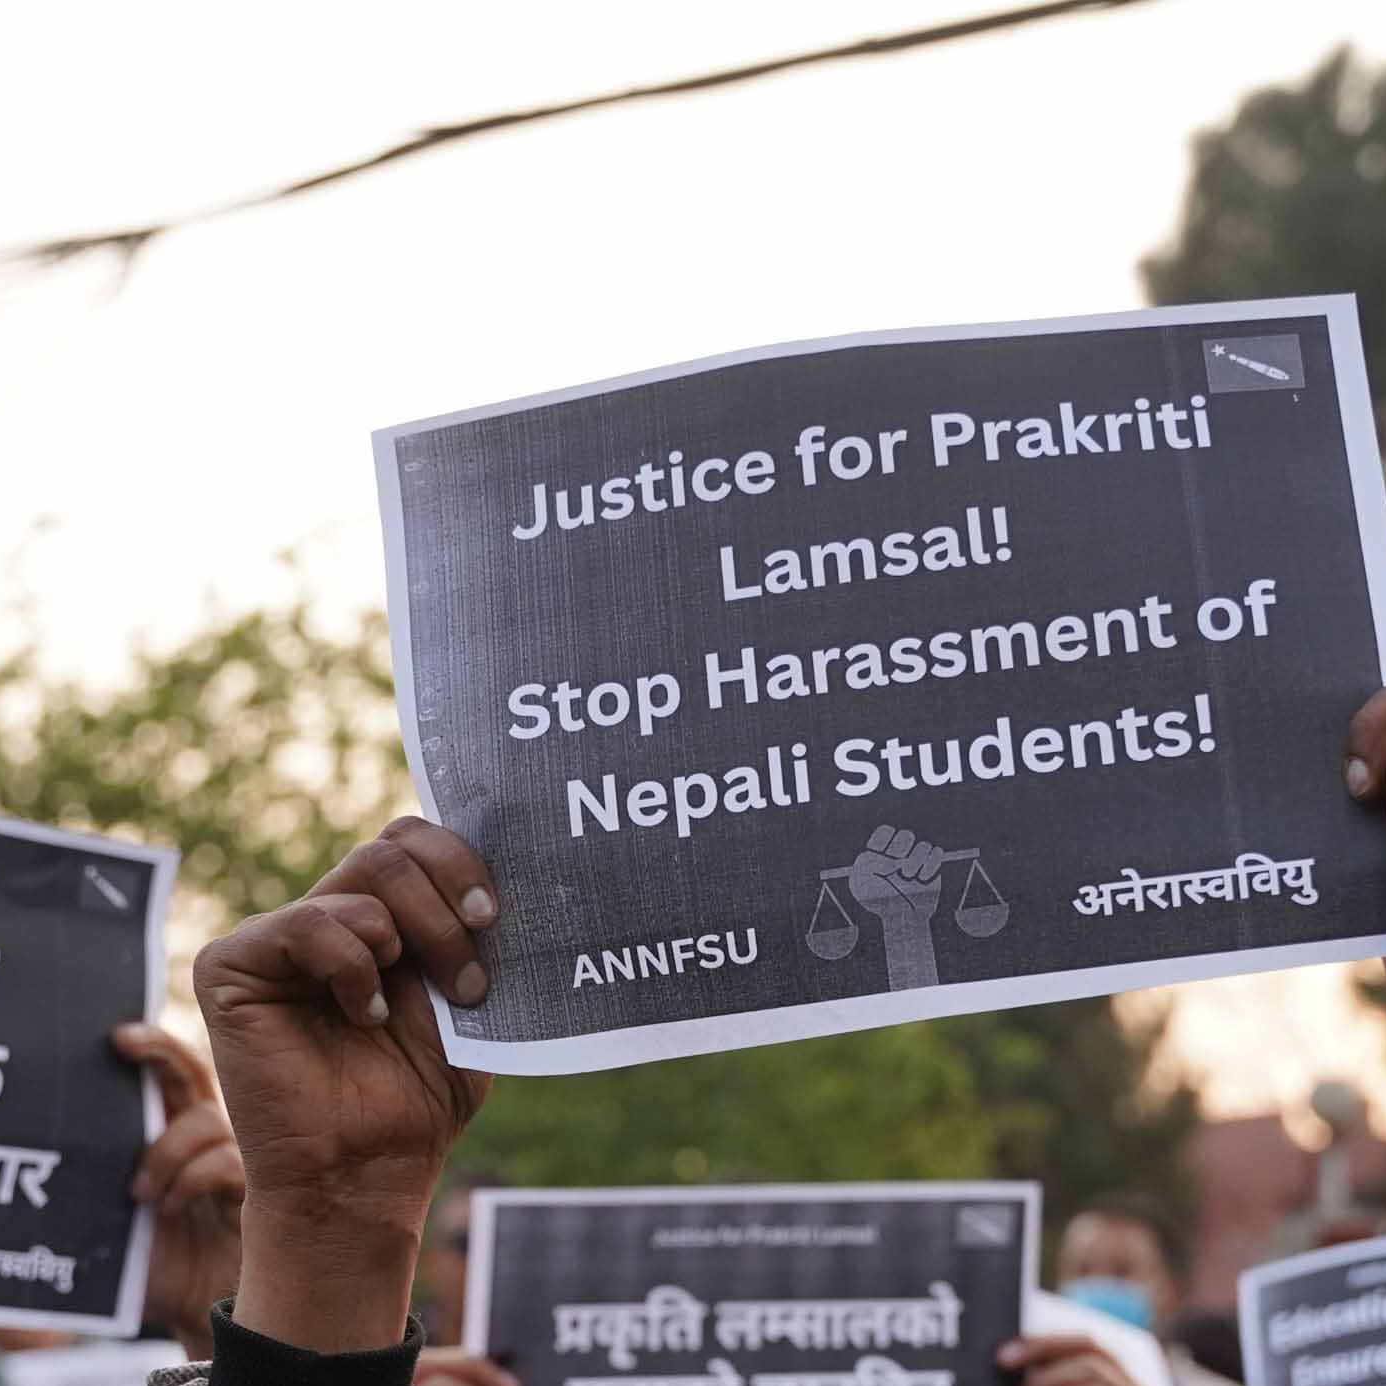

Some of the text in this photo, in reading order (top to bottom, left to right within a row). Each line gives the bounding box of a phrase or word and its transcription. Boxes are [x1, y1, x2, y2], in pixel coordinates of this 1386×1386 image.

[511, 393, 1212, 541] Justice for Prakriti
[719, 505, 1013, 601] Lamsal!
[506, 577, 1277, 740] Stop Harassment of
[567, 694, 1218, 839] Nepali Students!
[1071, 854, 1320, 921] अनेरास्ववियु
[571, 927, 759, 989] ANNFSU
[551, 1283, 709, 1371] प्रकृति
